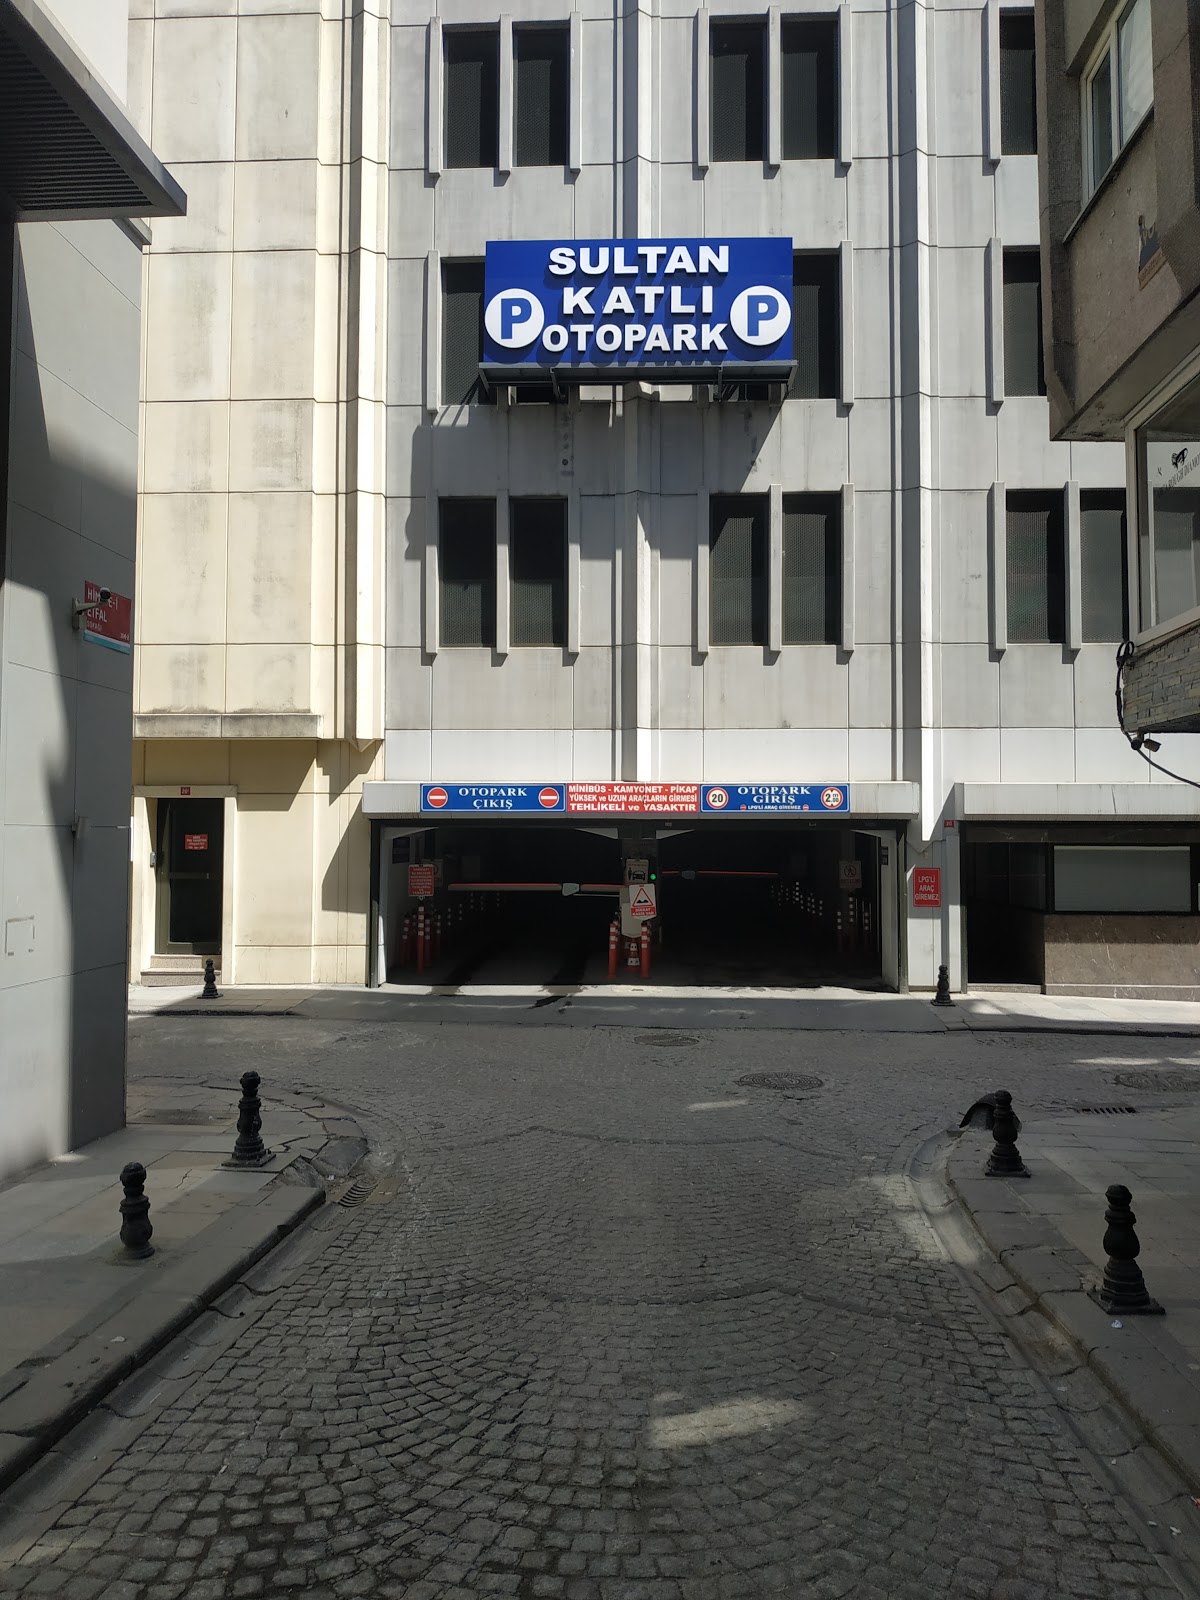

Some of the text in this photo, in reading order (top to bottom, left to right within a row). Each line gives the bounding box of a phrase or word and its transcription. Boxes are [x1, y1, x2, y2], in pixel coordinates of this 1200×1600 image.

[548, 245, 729, 275] SULTAN
[562, 285, 713, 315] KATLI
[500, 297, 532, 340] P
[747, 294, 779, 337] P
[541, 322, 728, 352] OTOPARK
[458, 787, 528, 797] OTOPARK
[568, 784, 606, 793] MİNİBÜS
[613, 785, 663, 793] KAMYONET
[670, 784, 698, 793] PİKAP
[737, 786, 811, 795] OTOPARK
[569, 794, 597, 802] YÜKSEK
[629, 795, 667, 804] ARAÇLARIN
[669, 794, 697, 802] GİRMESİ
[711, 794, 724, 803] 20
[752, 794, 796, 805] GİRİŞ
[472, 799, 513, 810] ÇIKIŞ
[570, 802, 625, 811] TEHLİKELİ
[643, 803, 696, 811] YASAKTIR
[918, 875, 936, 883] LPG'Lİ
[919, 884, 935, 893] ARAÇ
[915, 892, 939, 900] GİREMEZ
